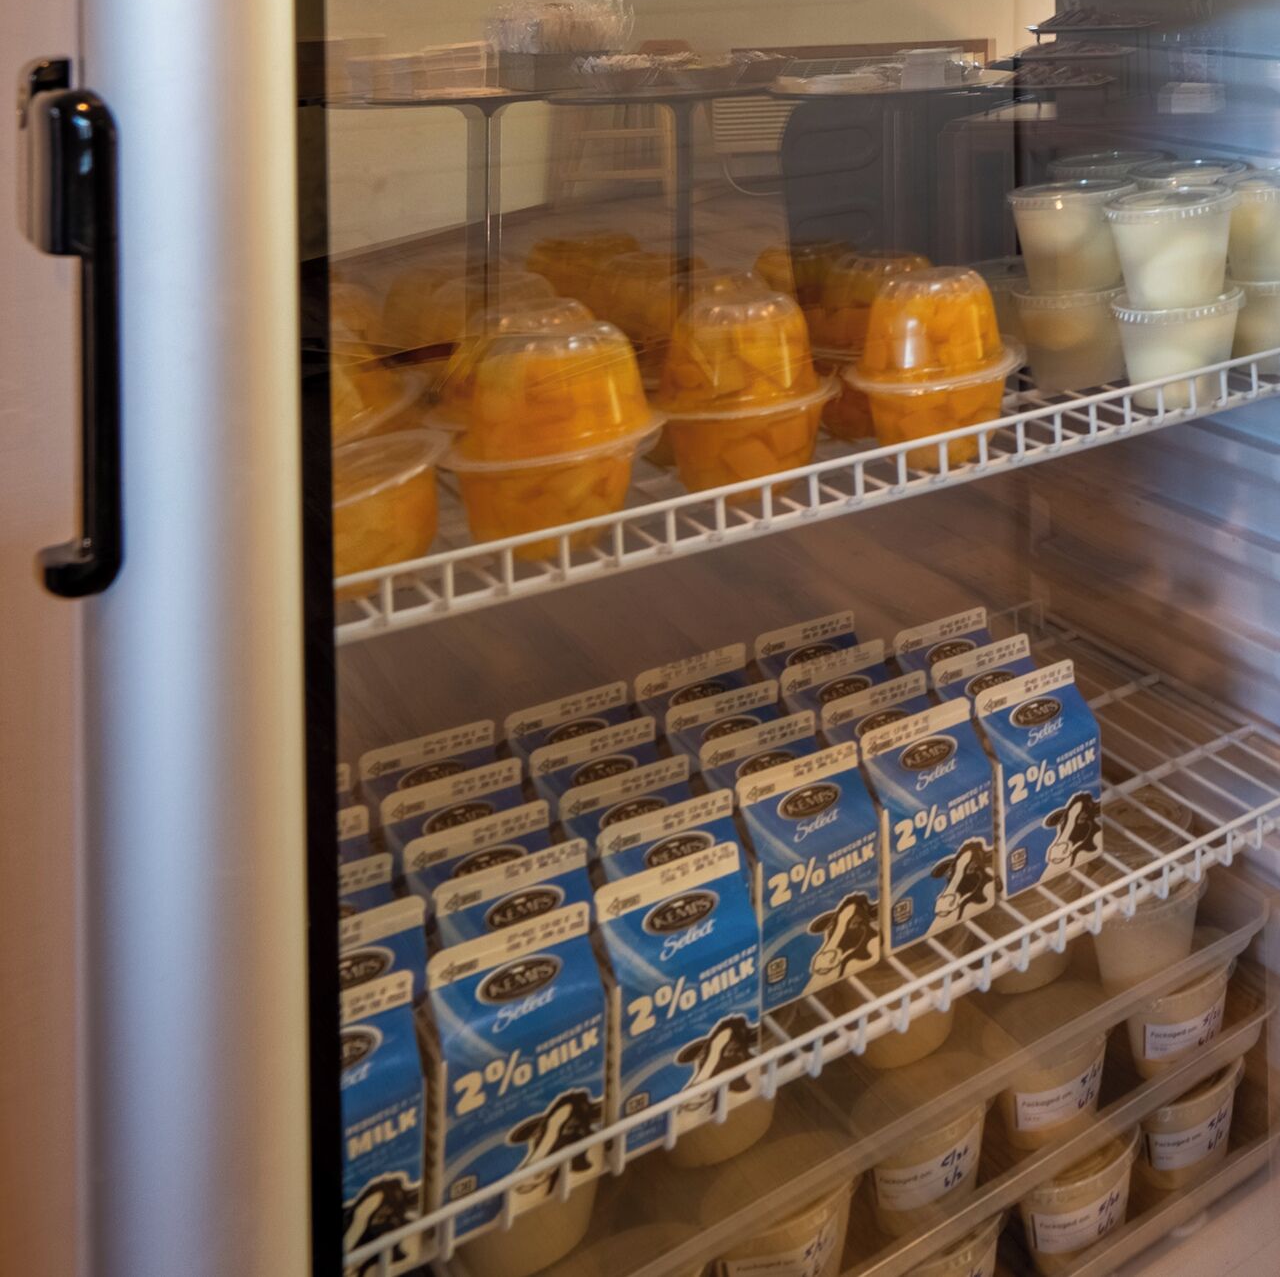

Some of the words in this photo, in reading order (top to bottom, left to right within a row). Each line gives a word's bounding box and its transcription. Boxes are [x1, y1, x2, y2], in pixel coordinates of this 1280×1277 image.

[1017, 702, 1060, 724] KEMPS
[1027, 716, 1065, 747] Select
[905, 743, 951, 768] KEMPS
[915, 757, 959, 791] Select
[1007, 759, 1056, 805] 2%
[1058, 747, 1096, 781] MILK
[784, 788, 836, 815] KEMPS
[793, 807, 841, 843] Select
[894, 804, 948, 853] 2%
[951, 790, 991, 826] MILK
[767, 856, 826, 909] 2%
[828, 841, 876, 880] MILK
[650, 894, 713, 930] KEMPS
[659, 918, 717, 962] Select
[486, 960, 556, 1001] KEMPS
[626, 975, 698, 1038] 2%
[700, 956, 756, 1002] MILK
[491, 985, 556, 1034] Select
[1150, 1027, 1187, 1039] Packaged
[453, 1047, 534, 1118] 2%
[537, 1026, 600, 1077] MILK
[1021, 1091, 1060, 1109] Packaged
[346, 1106, 418, 1162] MILK
[1154, 1134, 1190, 1150] Packaged
[1039, 1215, 1079, 1233] Packaged
